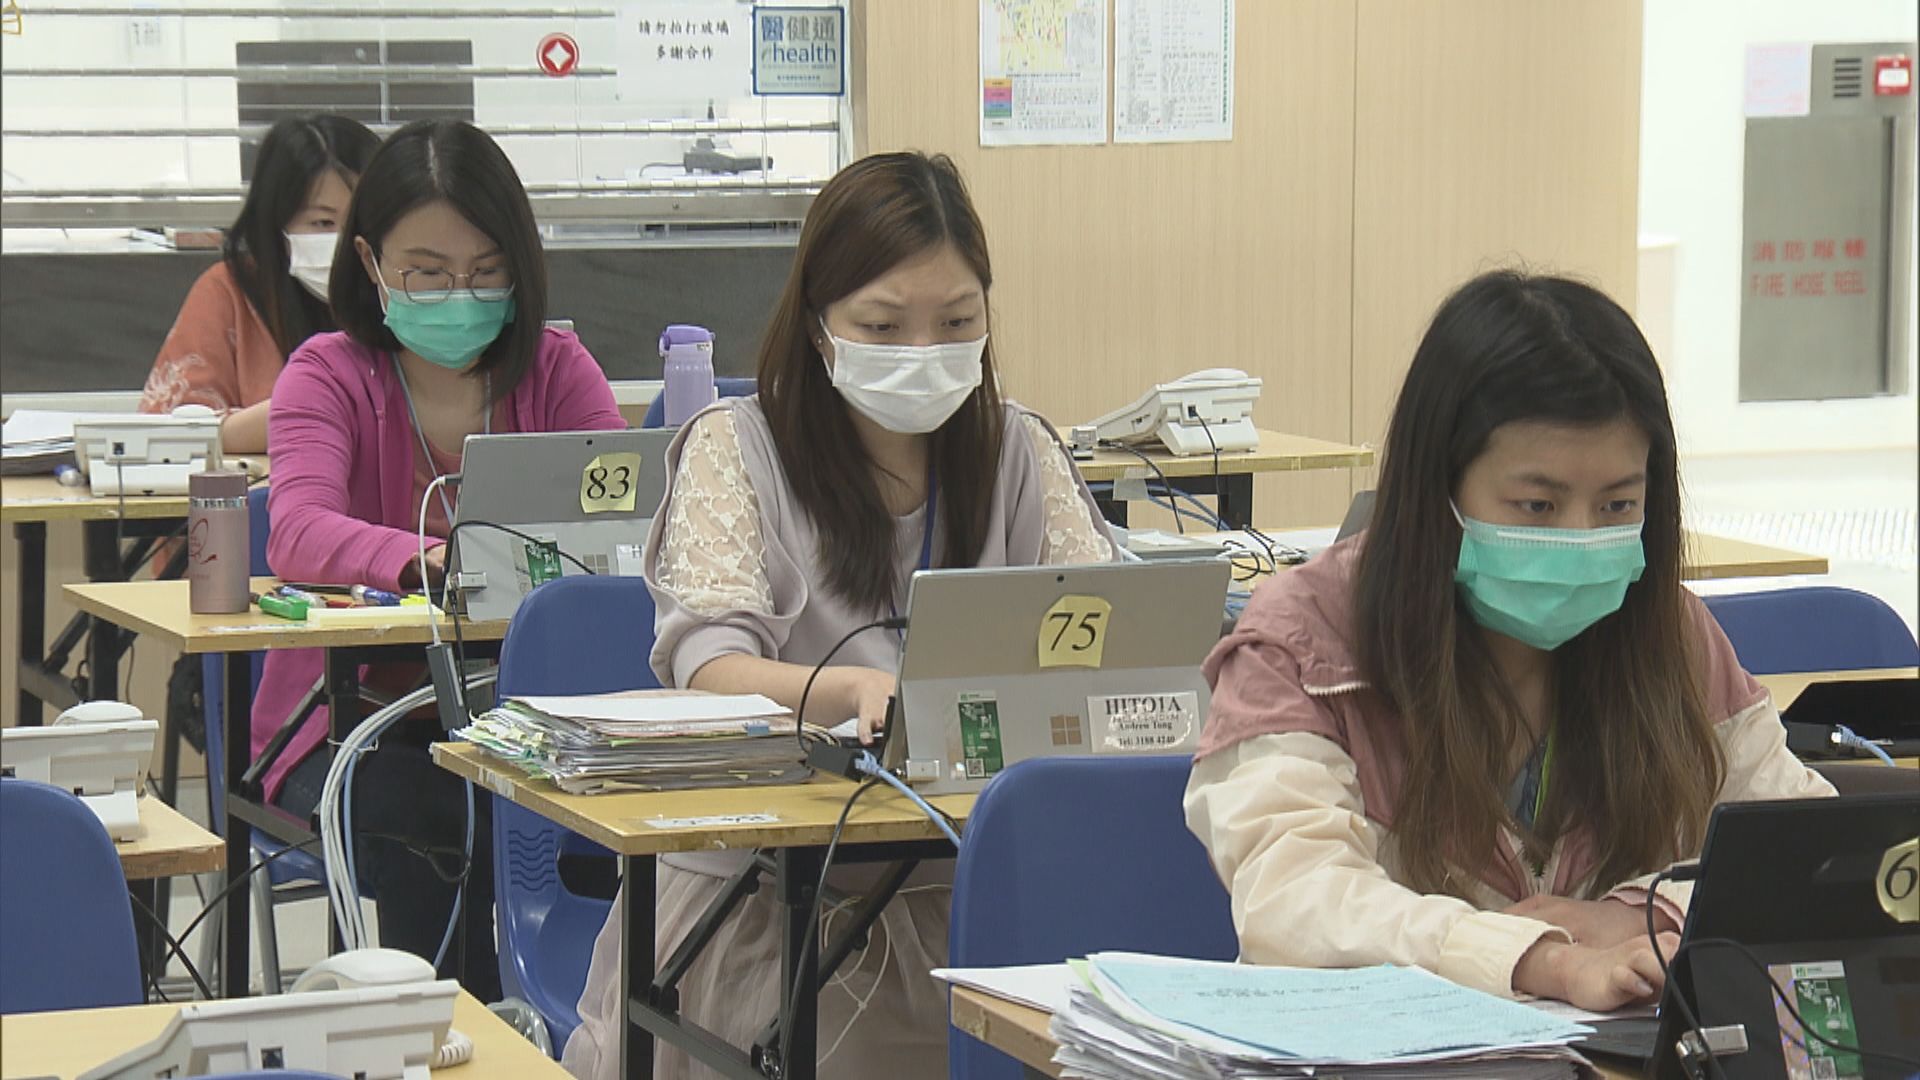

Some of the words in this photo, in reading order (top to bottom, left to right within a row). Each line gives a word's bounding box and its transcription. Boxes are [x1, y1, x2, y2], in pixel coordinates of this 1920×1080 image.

[656, 44, 714, 60] 多謝合作
[587, 466, 630, 499] 83
[1048, 612, 1102, 651] 75
